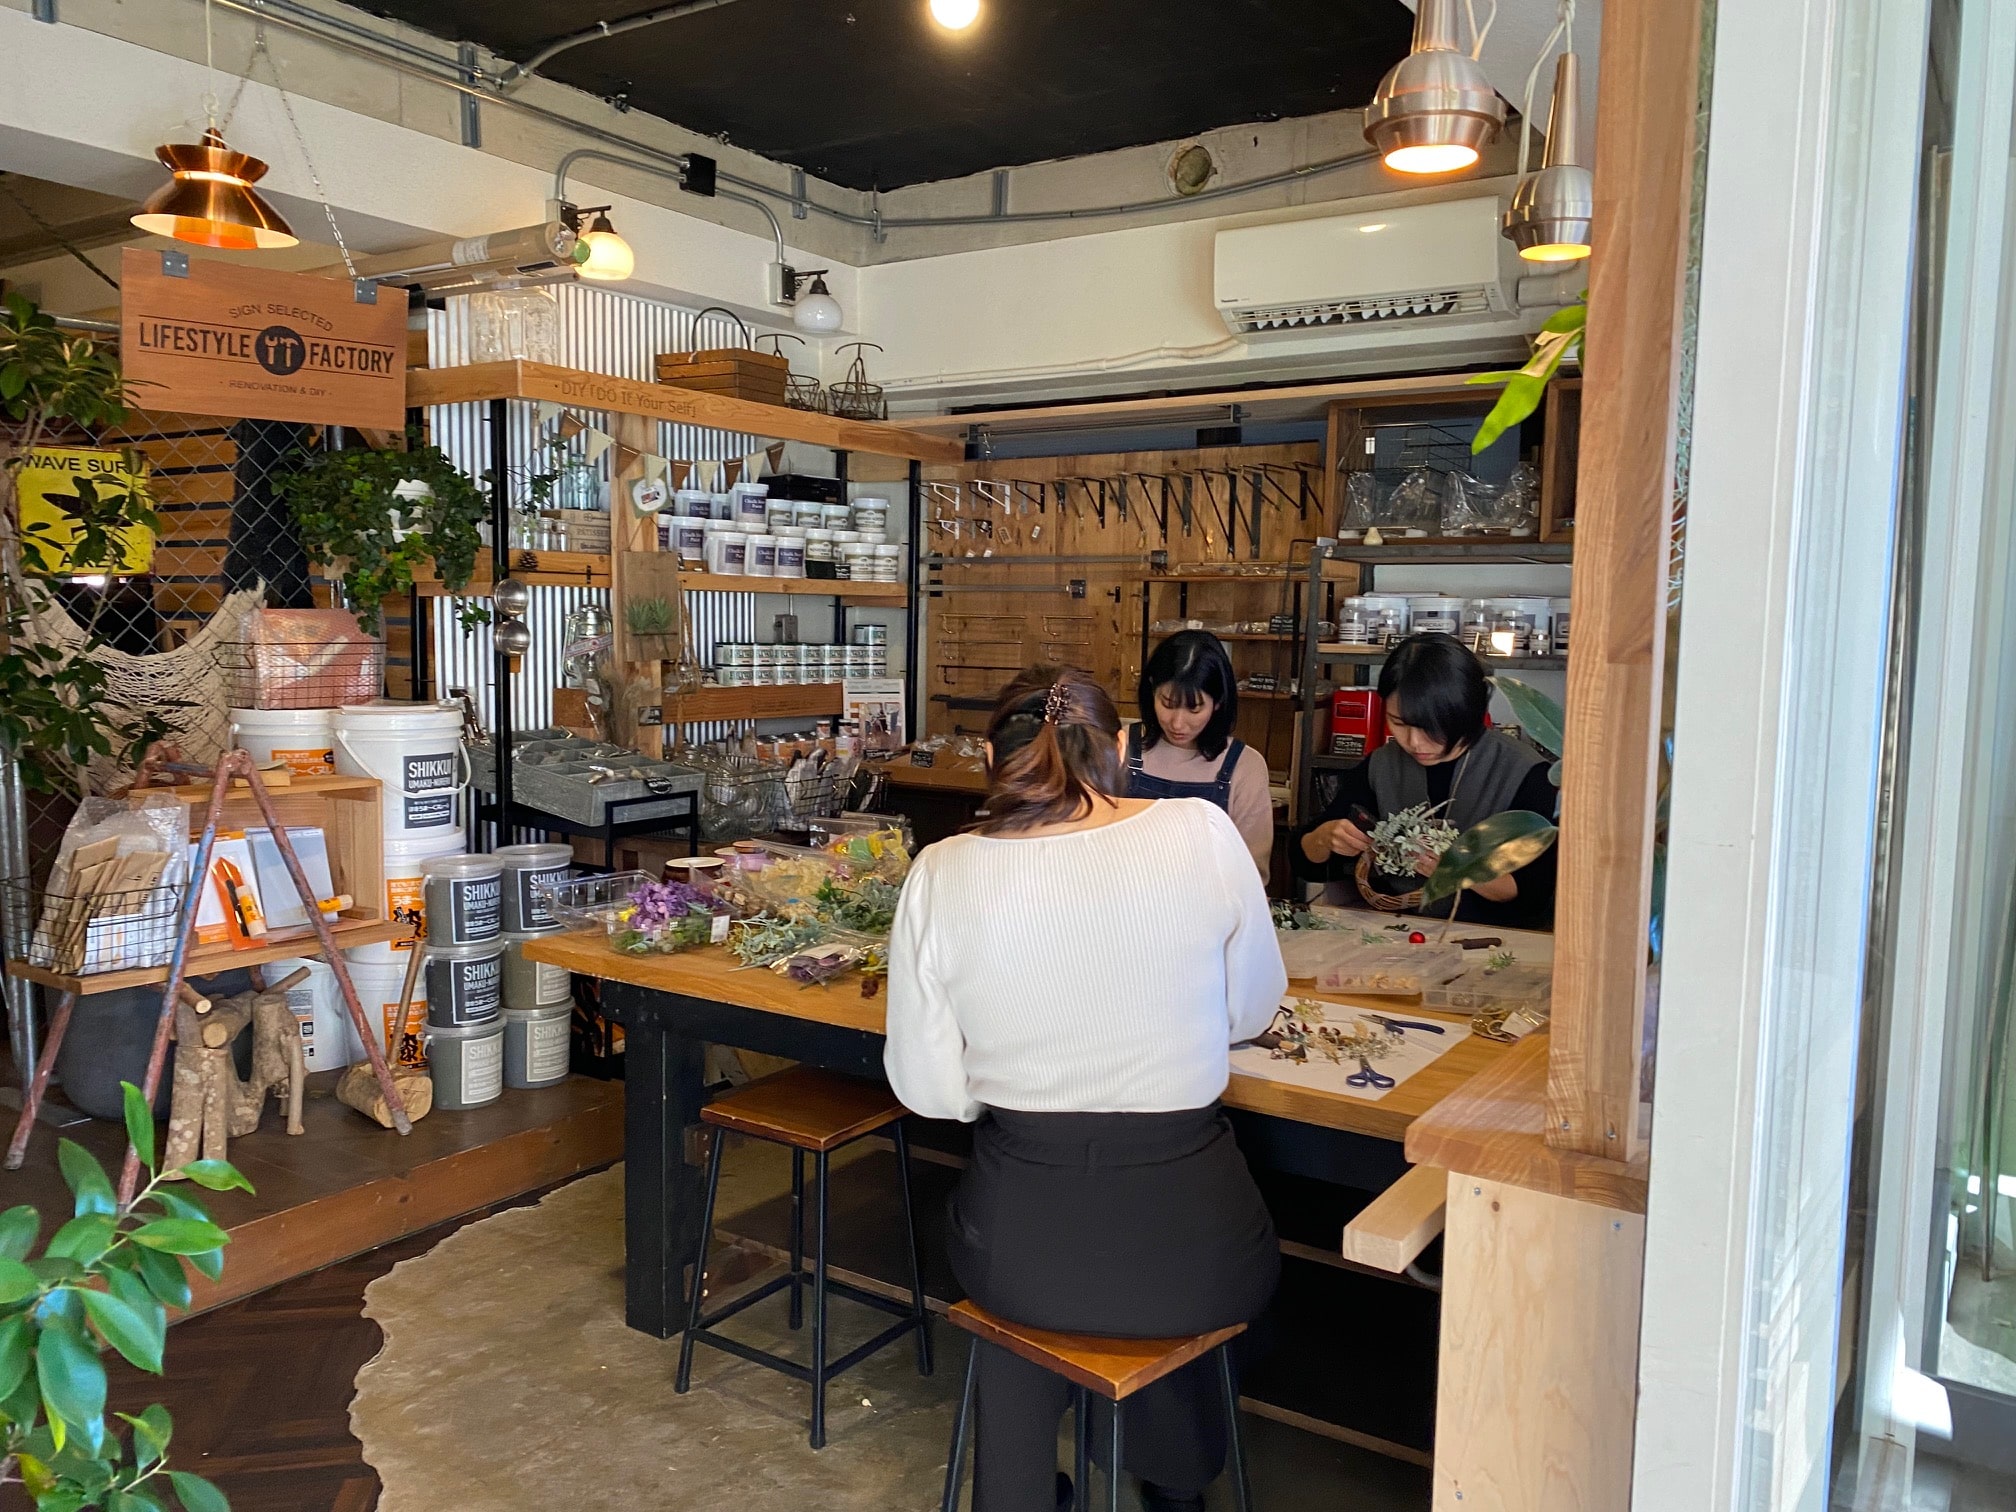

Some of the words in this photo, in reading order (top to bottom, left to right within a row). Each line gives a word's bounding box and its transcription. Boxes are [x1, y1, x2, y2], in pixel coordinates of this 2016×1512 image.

[228, 304, 261, 318] SIGN
[266, 303, 333, 332] SELECTED
[140, 321, 251, 358] LIFESTYLE
[309, 342, 394, 374] FACTORY
[229, 380, 297, 394] RENOVATION
[300, 386, 306, 395] &
[561, 381, 585, 397] DIY
[635, 393, 665, 411] Your
